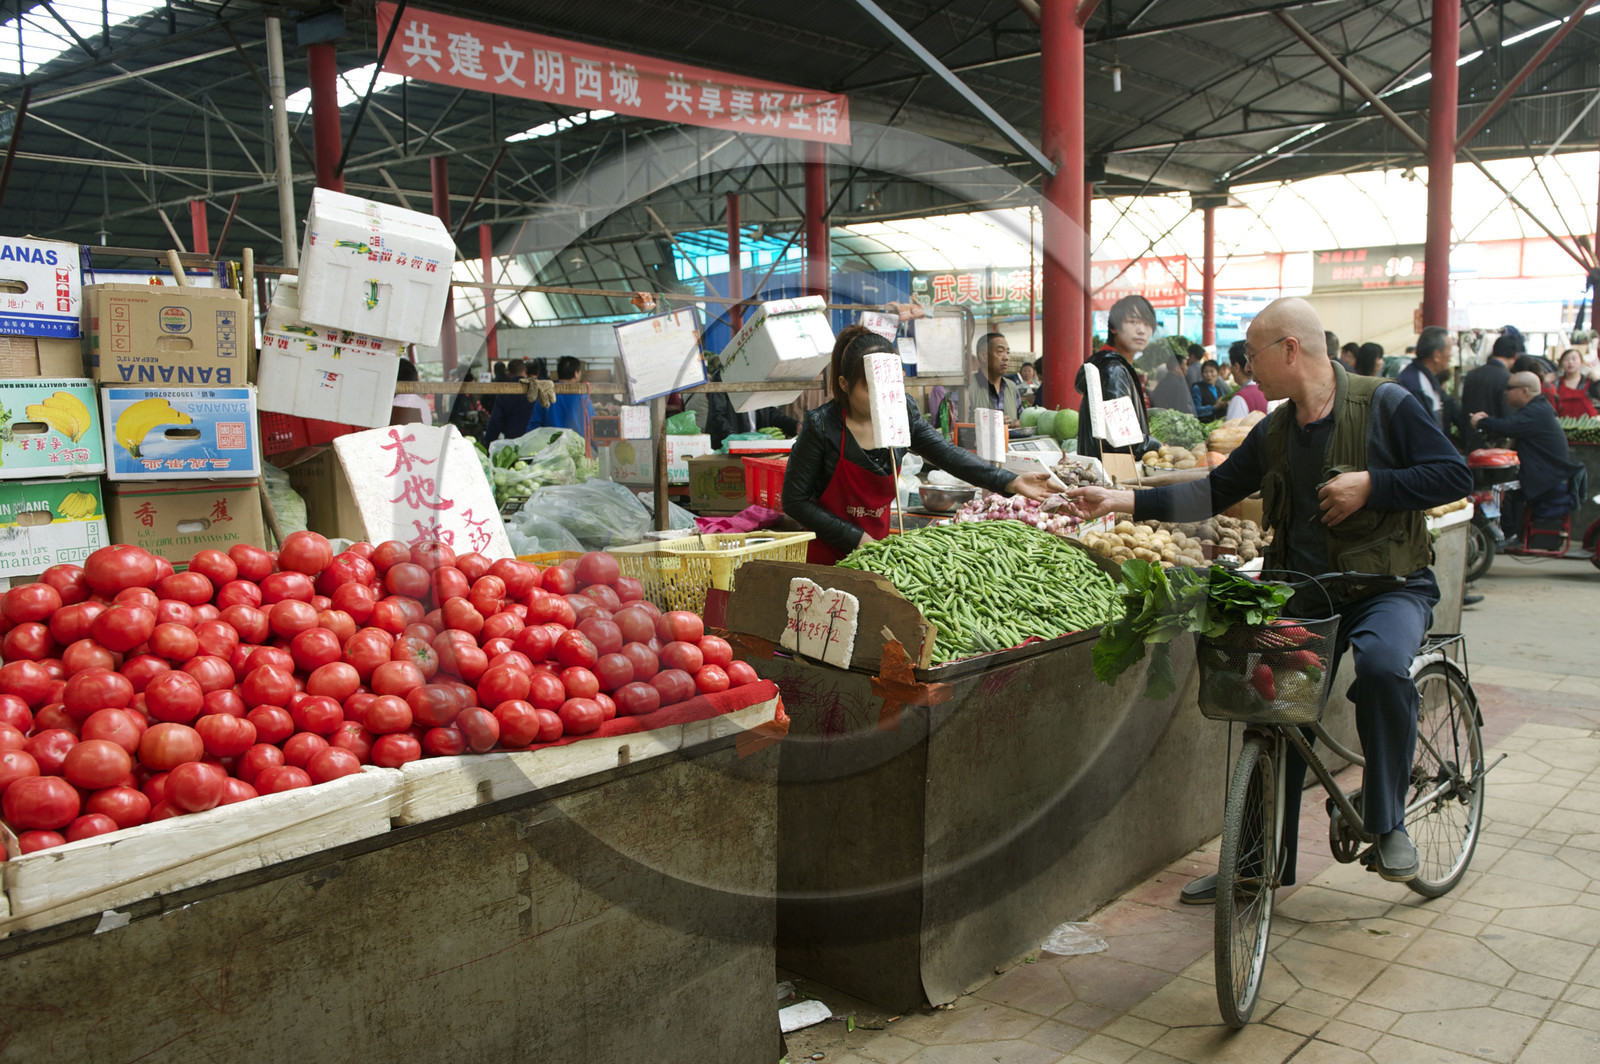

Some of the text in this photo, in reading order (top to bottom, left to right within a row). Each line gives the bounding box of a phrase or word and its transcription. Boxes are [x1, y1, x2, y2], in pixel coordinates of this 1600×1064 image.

[402, 20, 838, 136] 共建文明西城 共享美好生活
[0, 245, 58, 266] ANAS
[114, 306, 125, 318] 5
[115, 322, 125, 333] 4
[115, 338, 125, 349] 3
[117, 363, 231, 384] BANANA
[188, 403, 247, 413] BANANAS
[141, 458, 232, 470] 三成果业
[134, 497, 233, 527] 香蕉
[90, 525, 96, 533] 3
[91, 536, 97, 545] 4
[175, 536, 192, 545] CITY
[223, 532, 240, 541] KING
[60, 550, 88, 560] C 7 6
[0, 555, 51, 569] nanas
